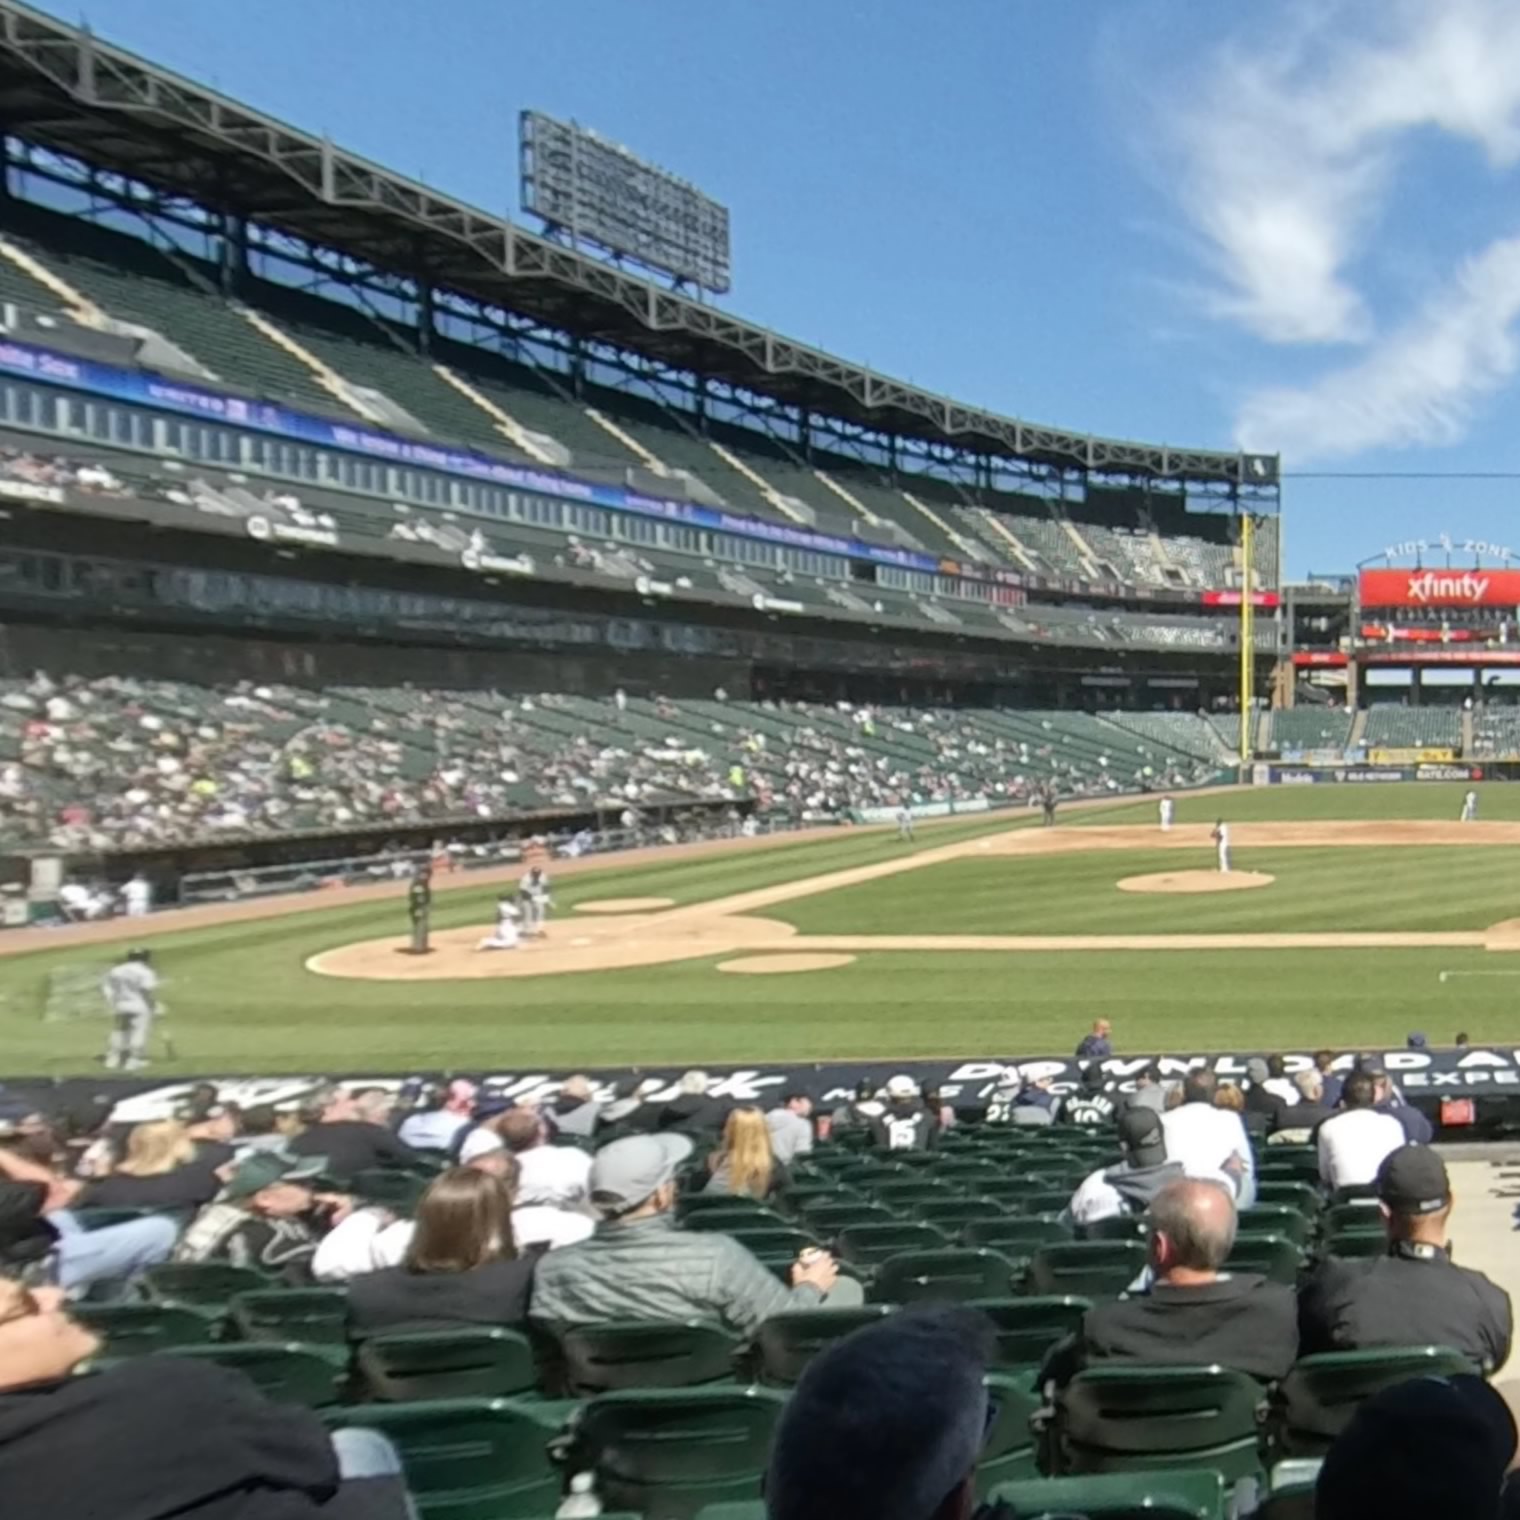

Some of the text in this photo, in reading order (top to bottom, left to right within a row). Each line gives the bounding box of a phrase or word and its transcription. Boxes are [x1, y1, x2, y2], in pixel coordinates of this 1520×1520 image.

[1385, 539, 1512, 560] KIDS ZONE
[1407, 572, 1490, 601] xfinity
[888, 1118, 917, 1149] 15
